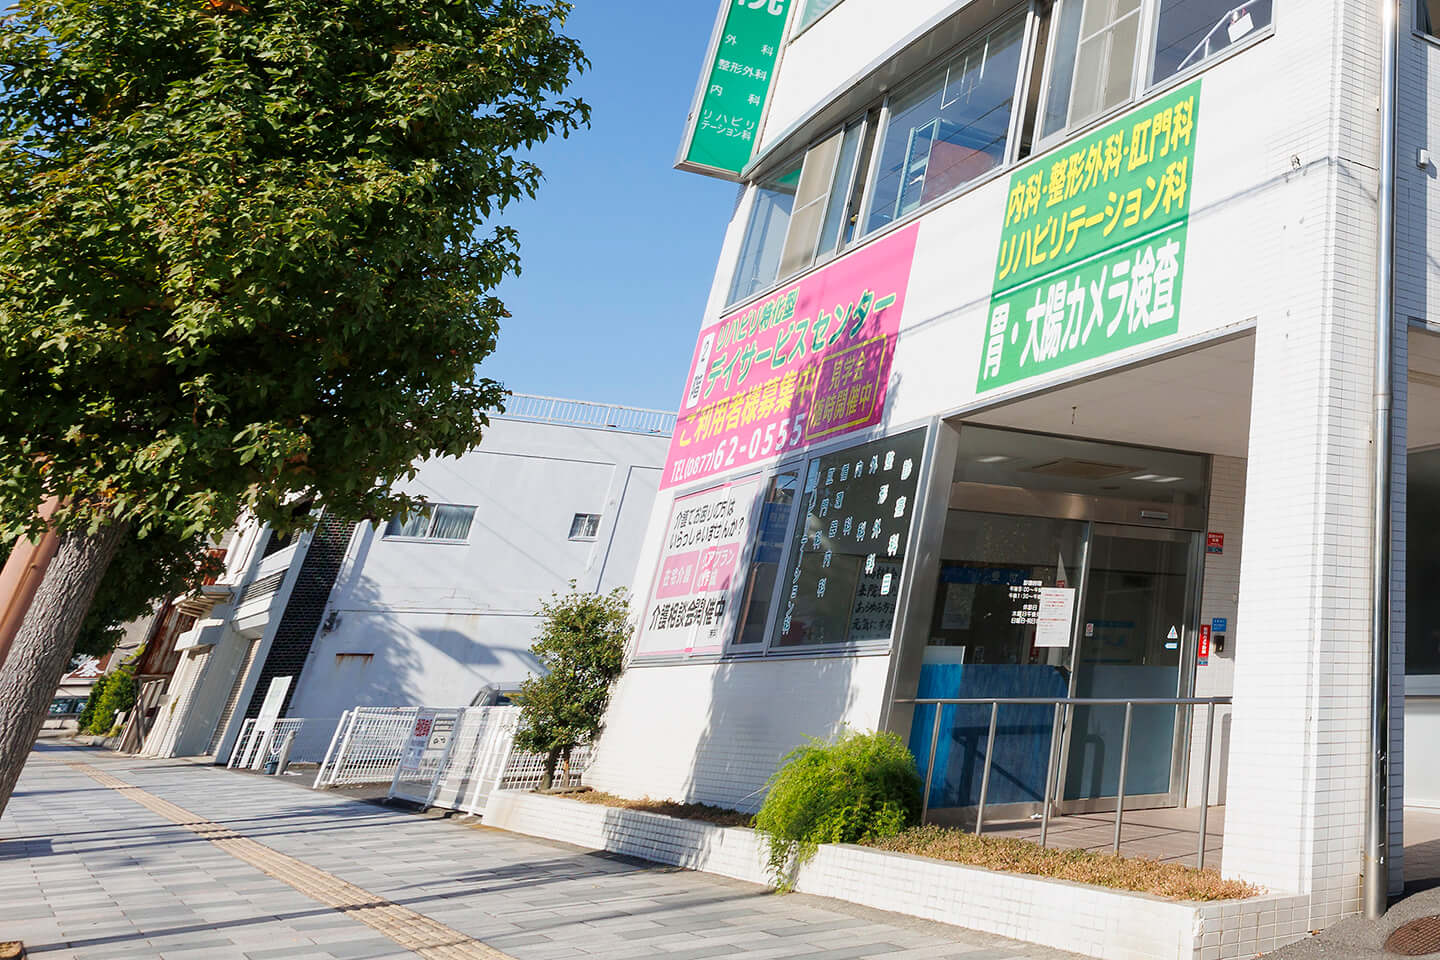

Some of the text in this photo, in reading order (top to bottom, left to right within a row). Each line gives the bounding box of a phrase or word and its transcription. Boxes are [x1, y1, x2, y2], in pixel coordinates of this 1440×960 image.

[718, 59, 767, 81] 整形外科
[701, 120, 752, 141] テーション科
[704, 109, 755, 130] リハビリ
[999, 156, 1188, 281] リハビリテーション科
[716, 286, 801, 352] リハビリ特化型
[983, 238, 1180, 381] 胃・大腸カメラ検査
[703, 288, 897, 400] デイサービスセンター
[829, 351, 866, 391] 見学会
[679, 362, 818, 448] ご利用者様募集中
